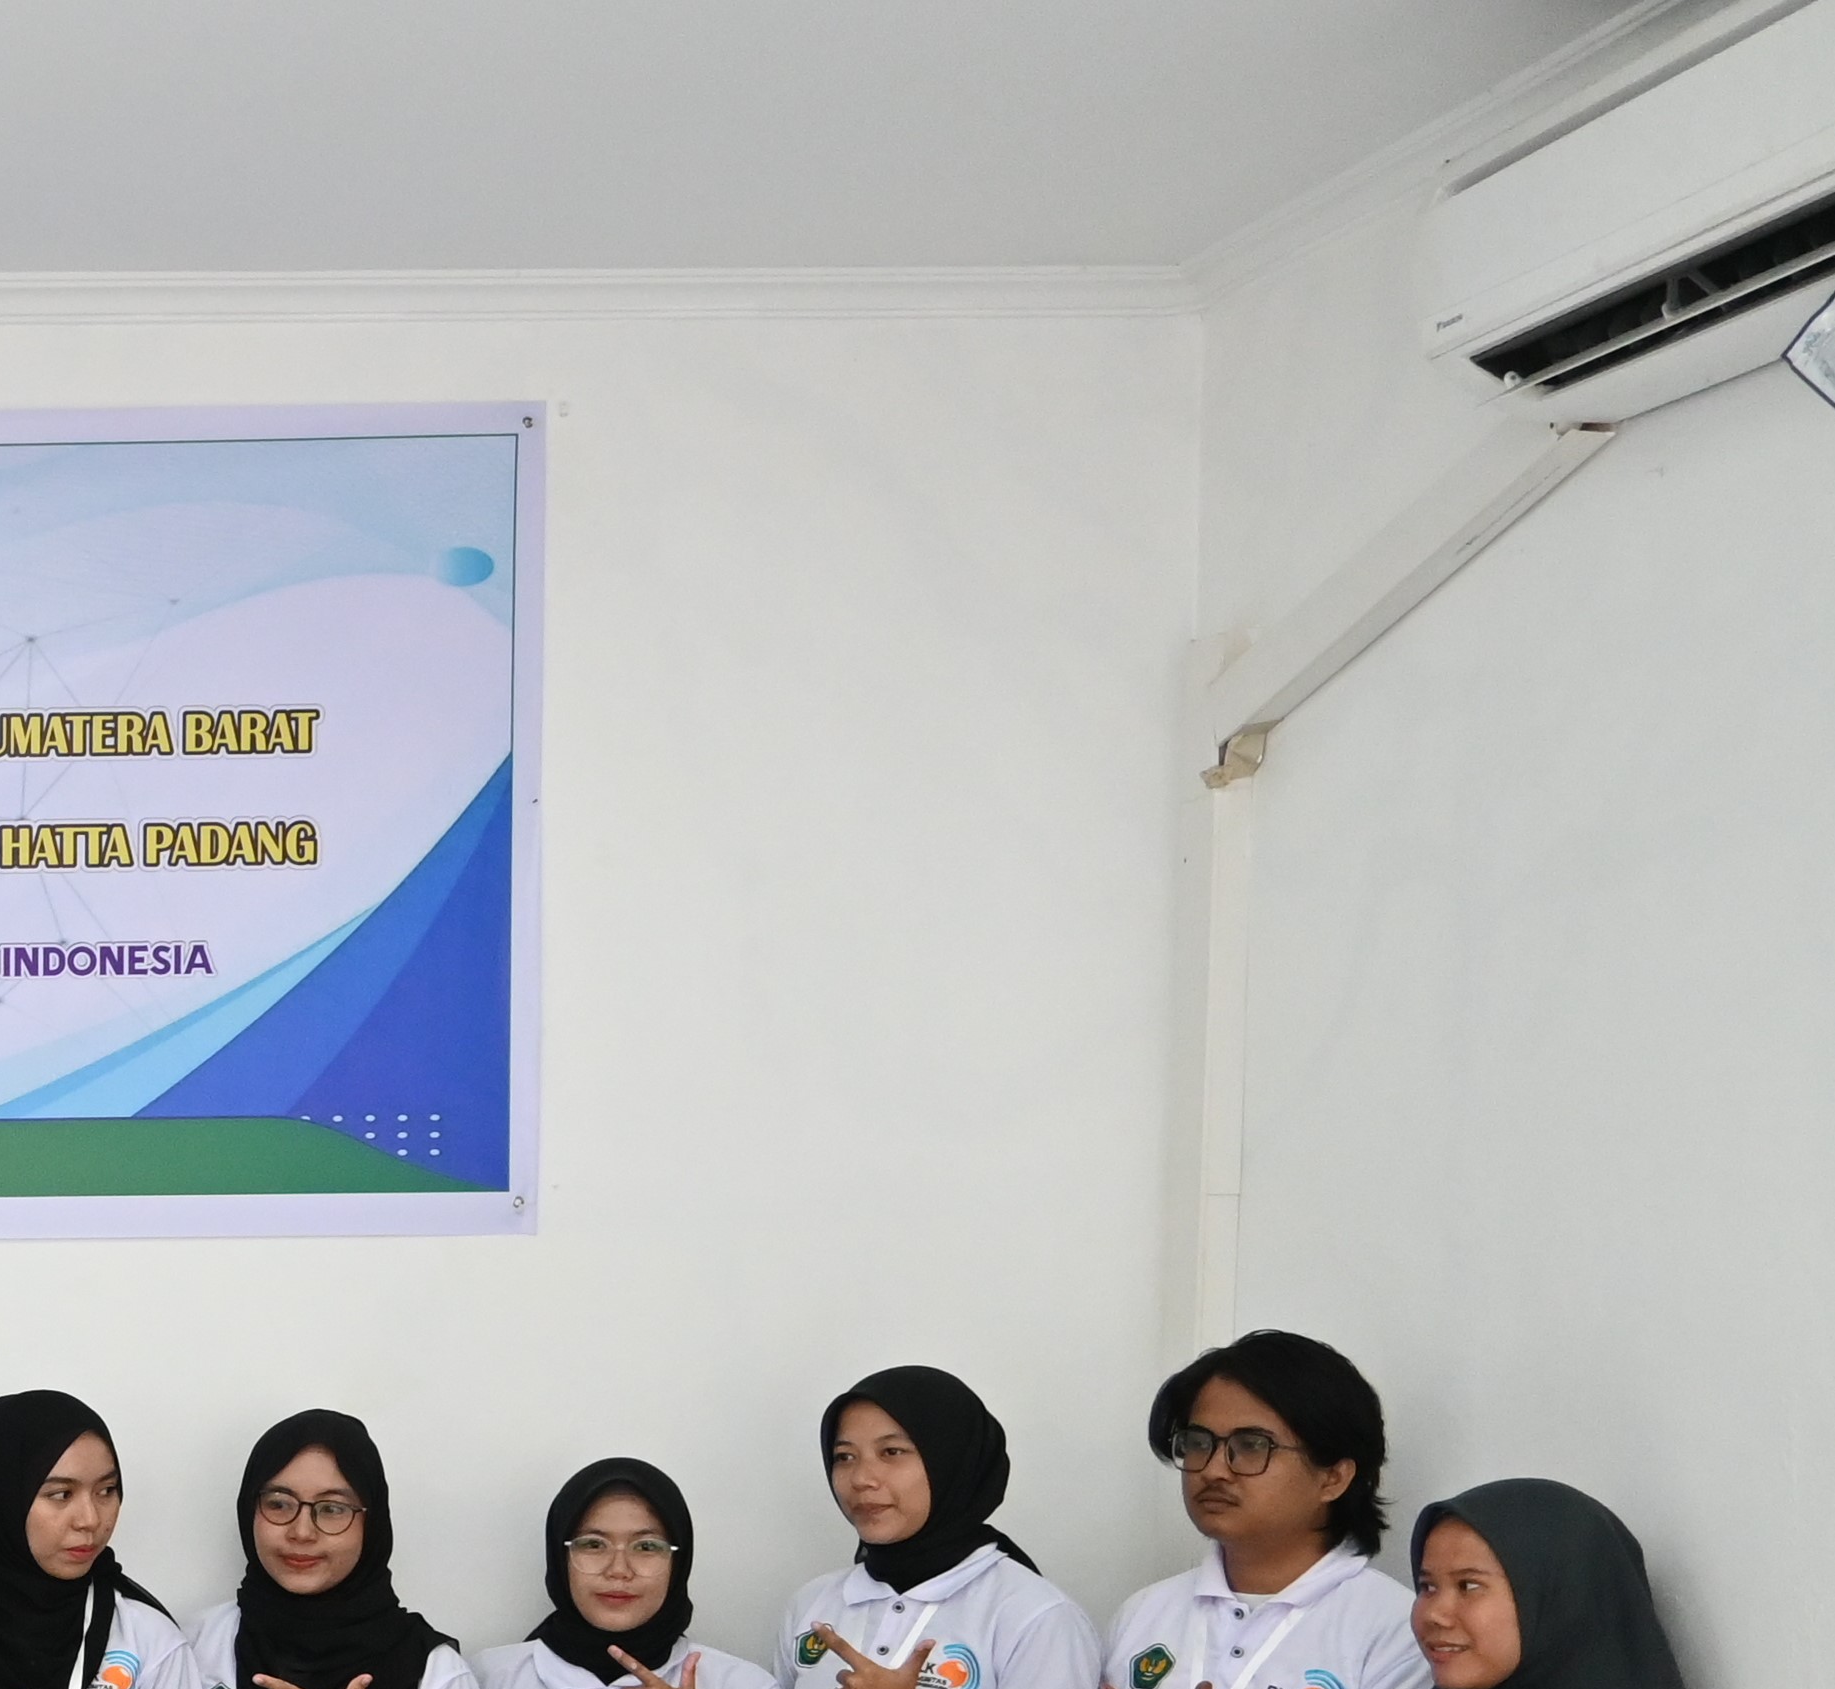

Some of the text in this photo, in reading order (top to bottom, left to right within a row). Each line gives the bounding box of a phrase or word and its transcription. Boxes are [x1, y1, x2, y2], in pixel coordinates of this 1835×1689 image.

[183, 709, 320, 755] BARAT
[0, 824, 134, 869] HATTA
[143, 821, 317, 867] PADANG
[4, 945, 212, 976] INDONESIA
